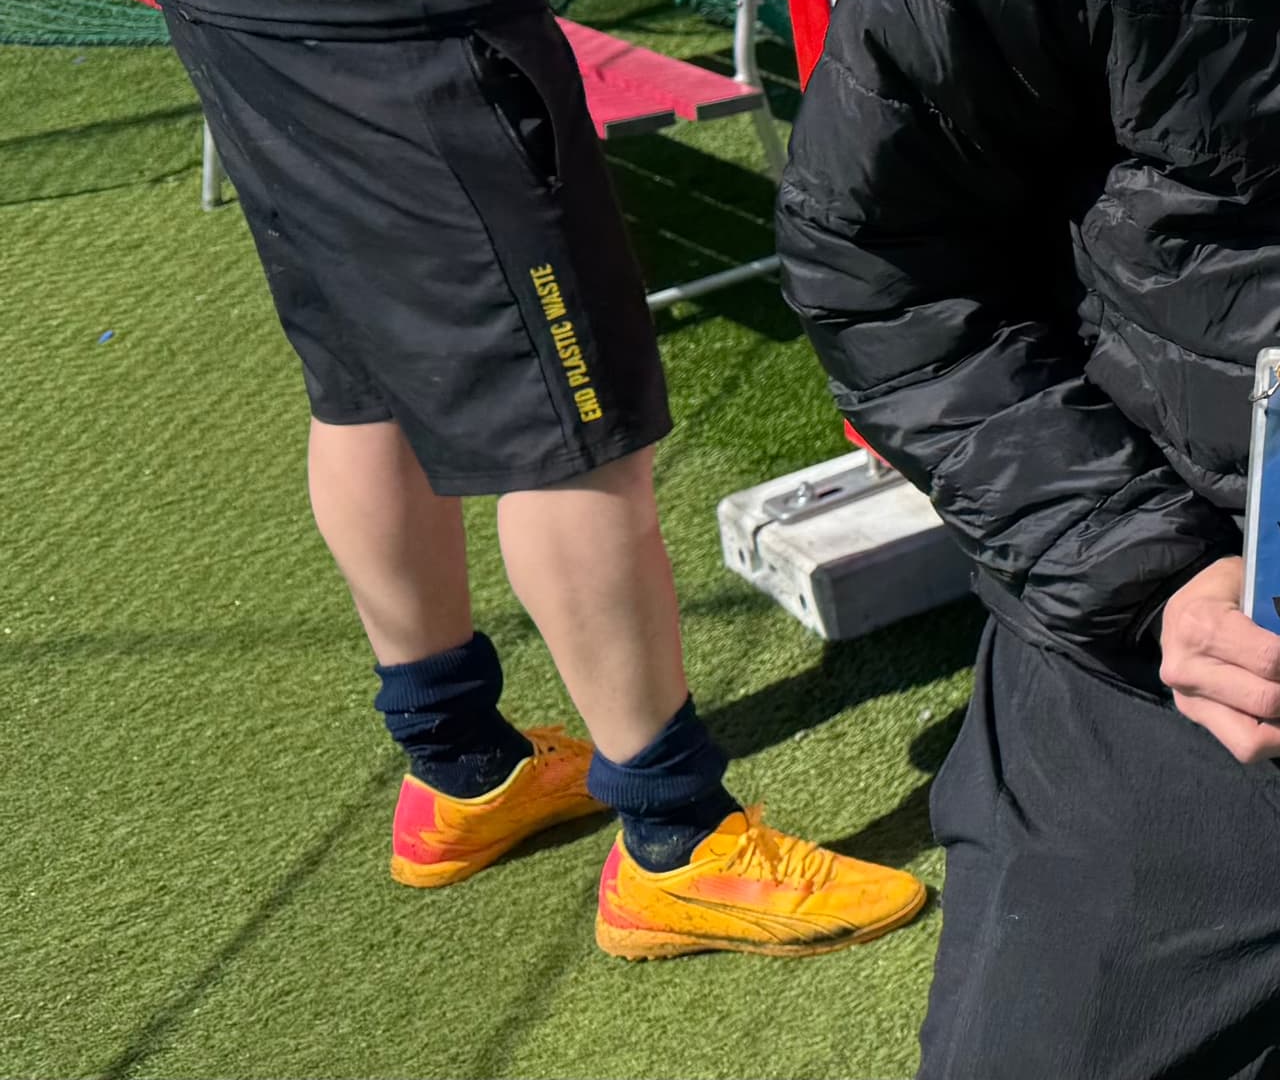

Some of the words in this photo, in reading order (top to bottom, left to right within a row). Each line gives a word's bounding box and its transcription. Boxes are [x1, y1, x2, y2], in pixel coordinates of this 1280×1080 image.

[529, 263, 565, 320] WASTE
[550, 321, 590, 388] PLASTIC
[573, 387, 603, 423] END
